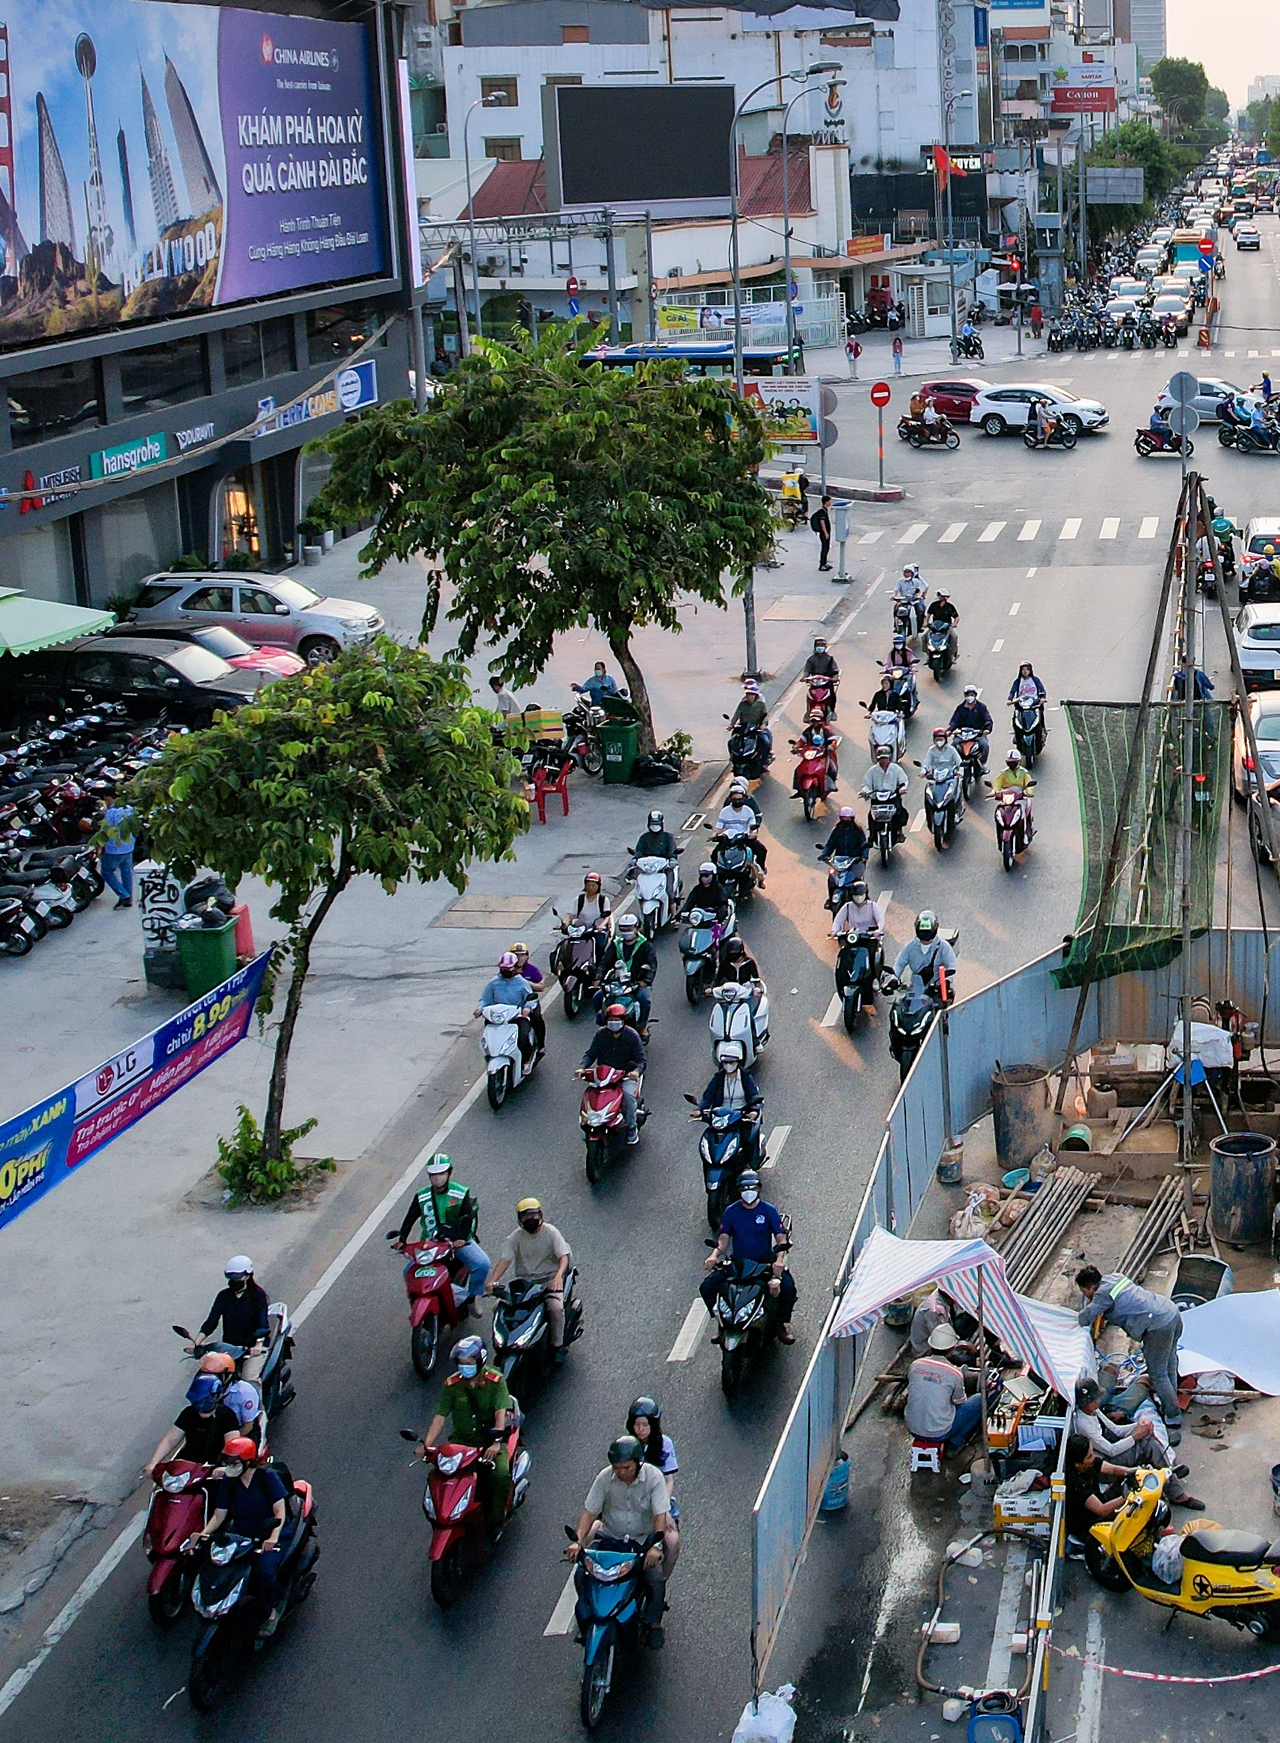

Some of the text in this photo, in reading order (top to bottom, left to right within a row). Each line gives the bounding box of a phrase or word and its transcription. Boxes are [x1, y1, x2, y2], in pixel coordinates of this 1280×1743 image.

[274, 48, 329, 67] CHINA AIRLINES
[1066, 90, 1099, 99] Canon
[238, 107, 363, 146] KHÁM PHÁ HOA KỲ
[242, 148, 367, 194] QUÁ CẢNH ĐÀI BẮC
[102, 437, 161, 475] hansgrohe
[117, 1051, 137, 1080] LG
[30, 1097, 67, 1134] XANH
